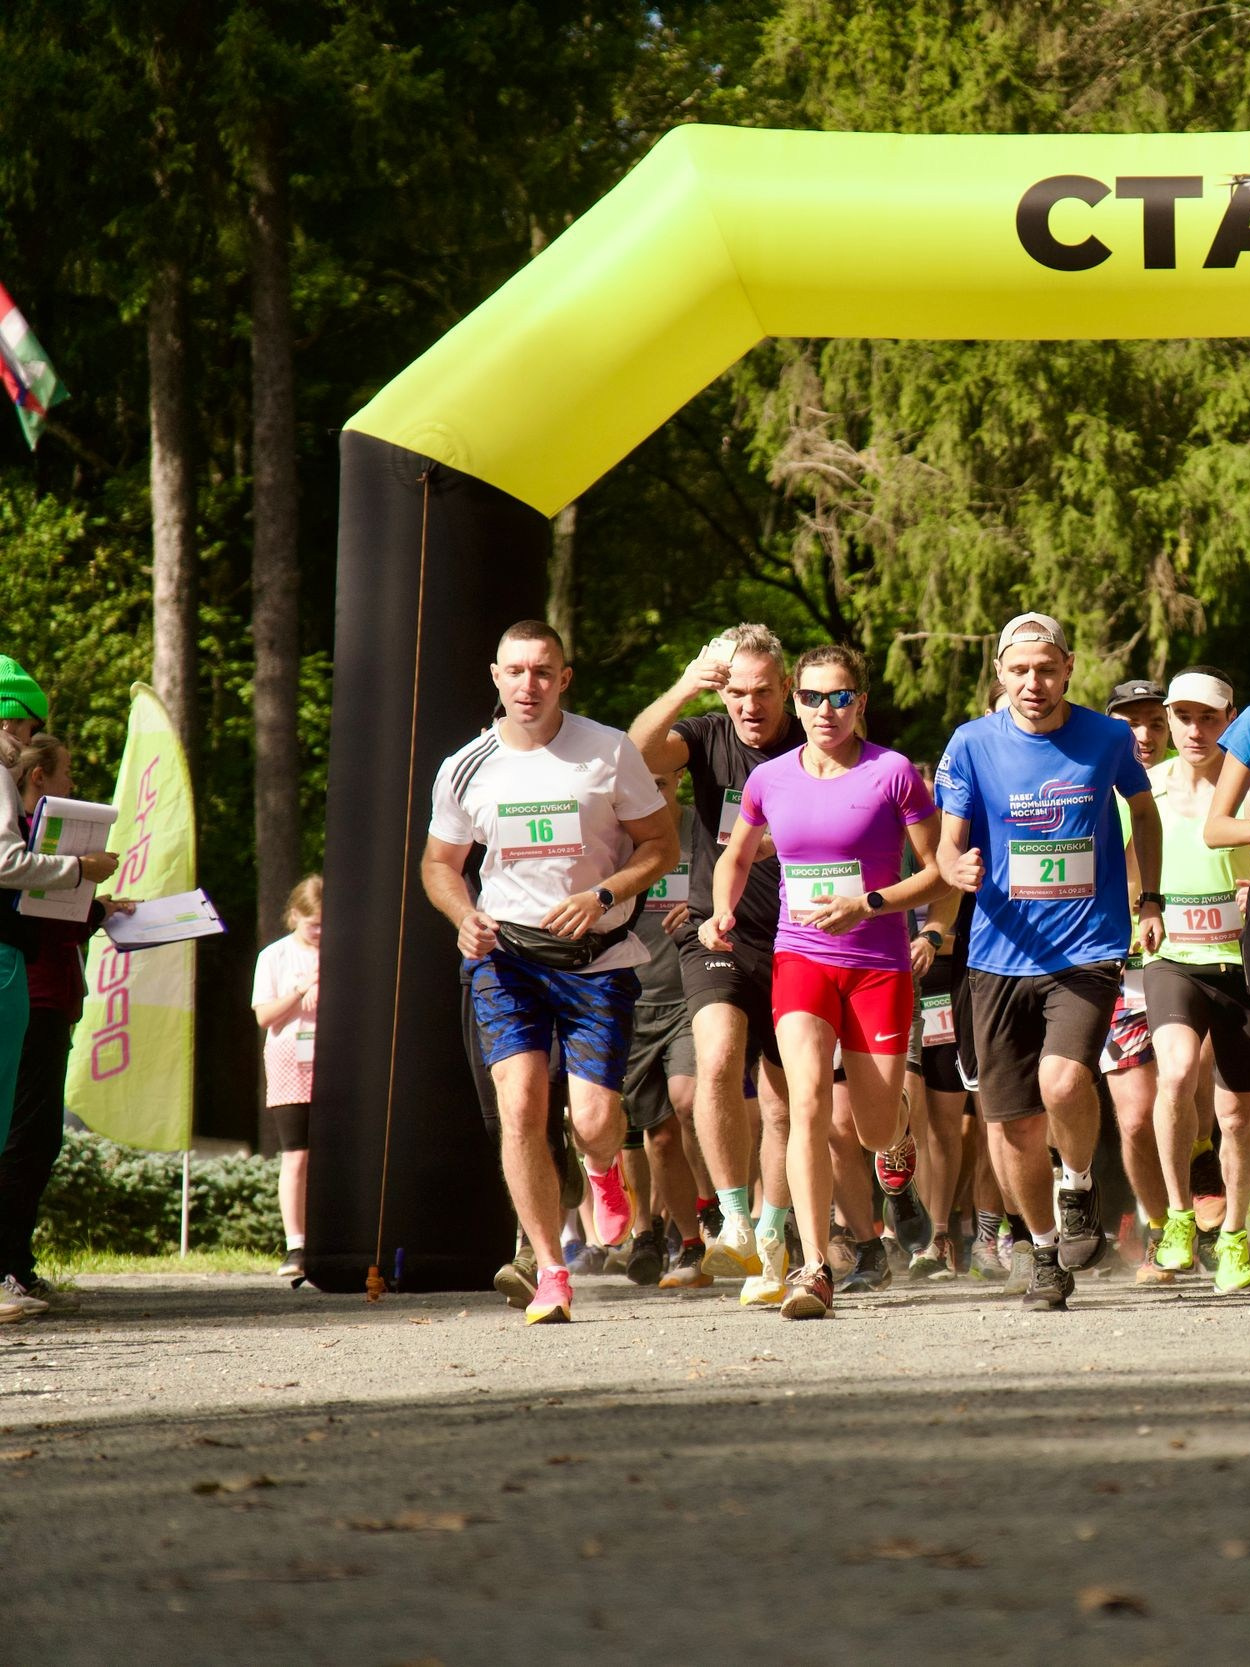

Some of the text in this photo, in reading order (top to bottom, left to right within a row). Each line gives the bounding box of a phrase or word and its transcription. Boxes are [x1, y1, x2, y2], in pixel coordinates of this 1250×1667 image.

[1009, 793, 1034, 801] ЗАБЕГ
[1009, 795, 1094, 809] ПРОМЫШЛЕННОСТИ
[505, 803, 571, 814] КРОСС ДУБКИ
[1010, 808, 1048, 817] МОСКВЫ
[525, 818, 554, 843] 16
[1019, 843, 1086, 853] КРОСС ДУБКИ
[791, 866, 852, 876] КРОСС ДУБКИ
[1039, 857, 1066, 883] 21
[1171, 894, 1231, 905] КРОСС ДУБКИ
[1183, 907, 1223, 931] 120
